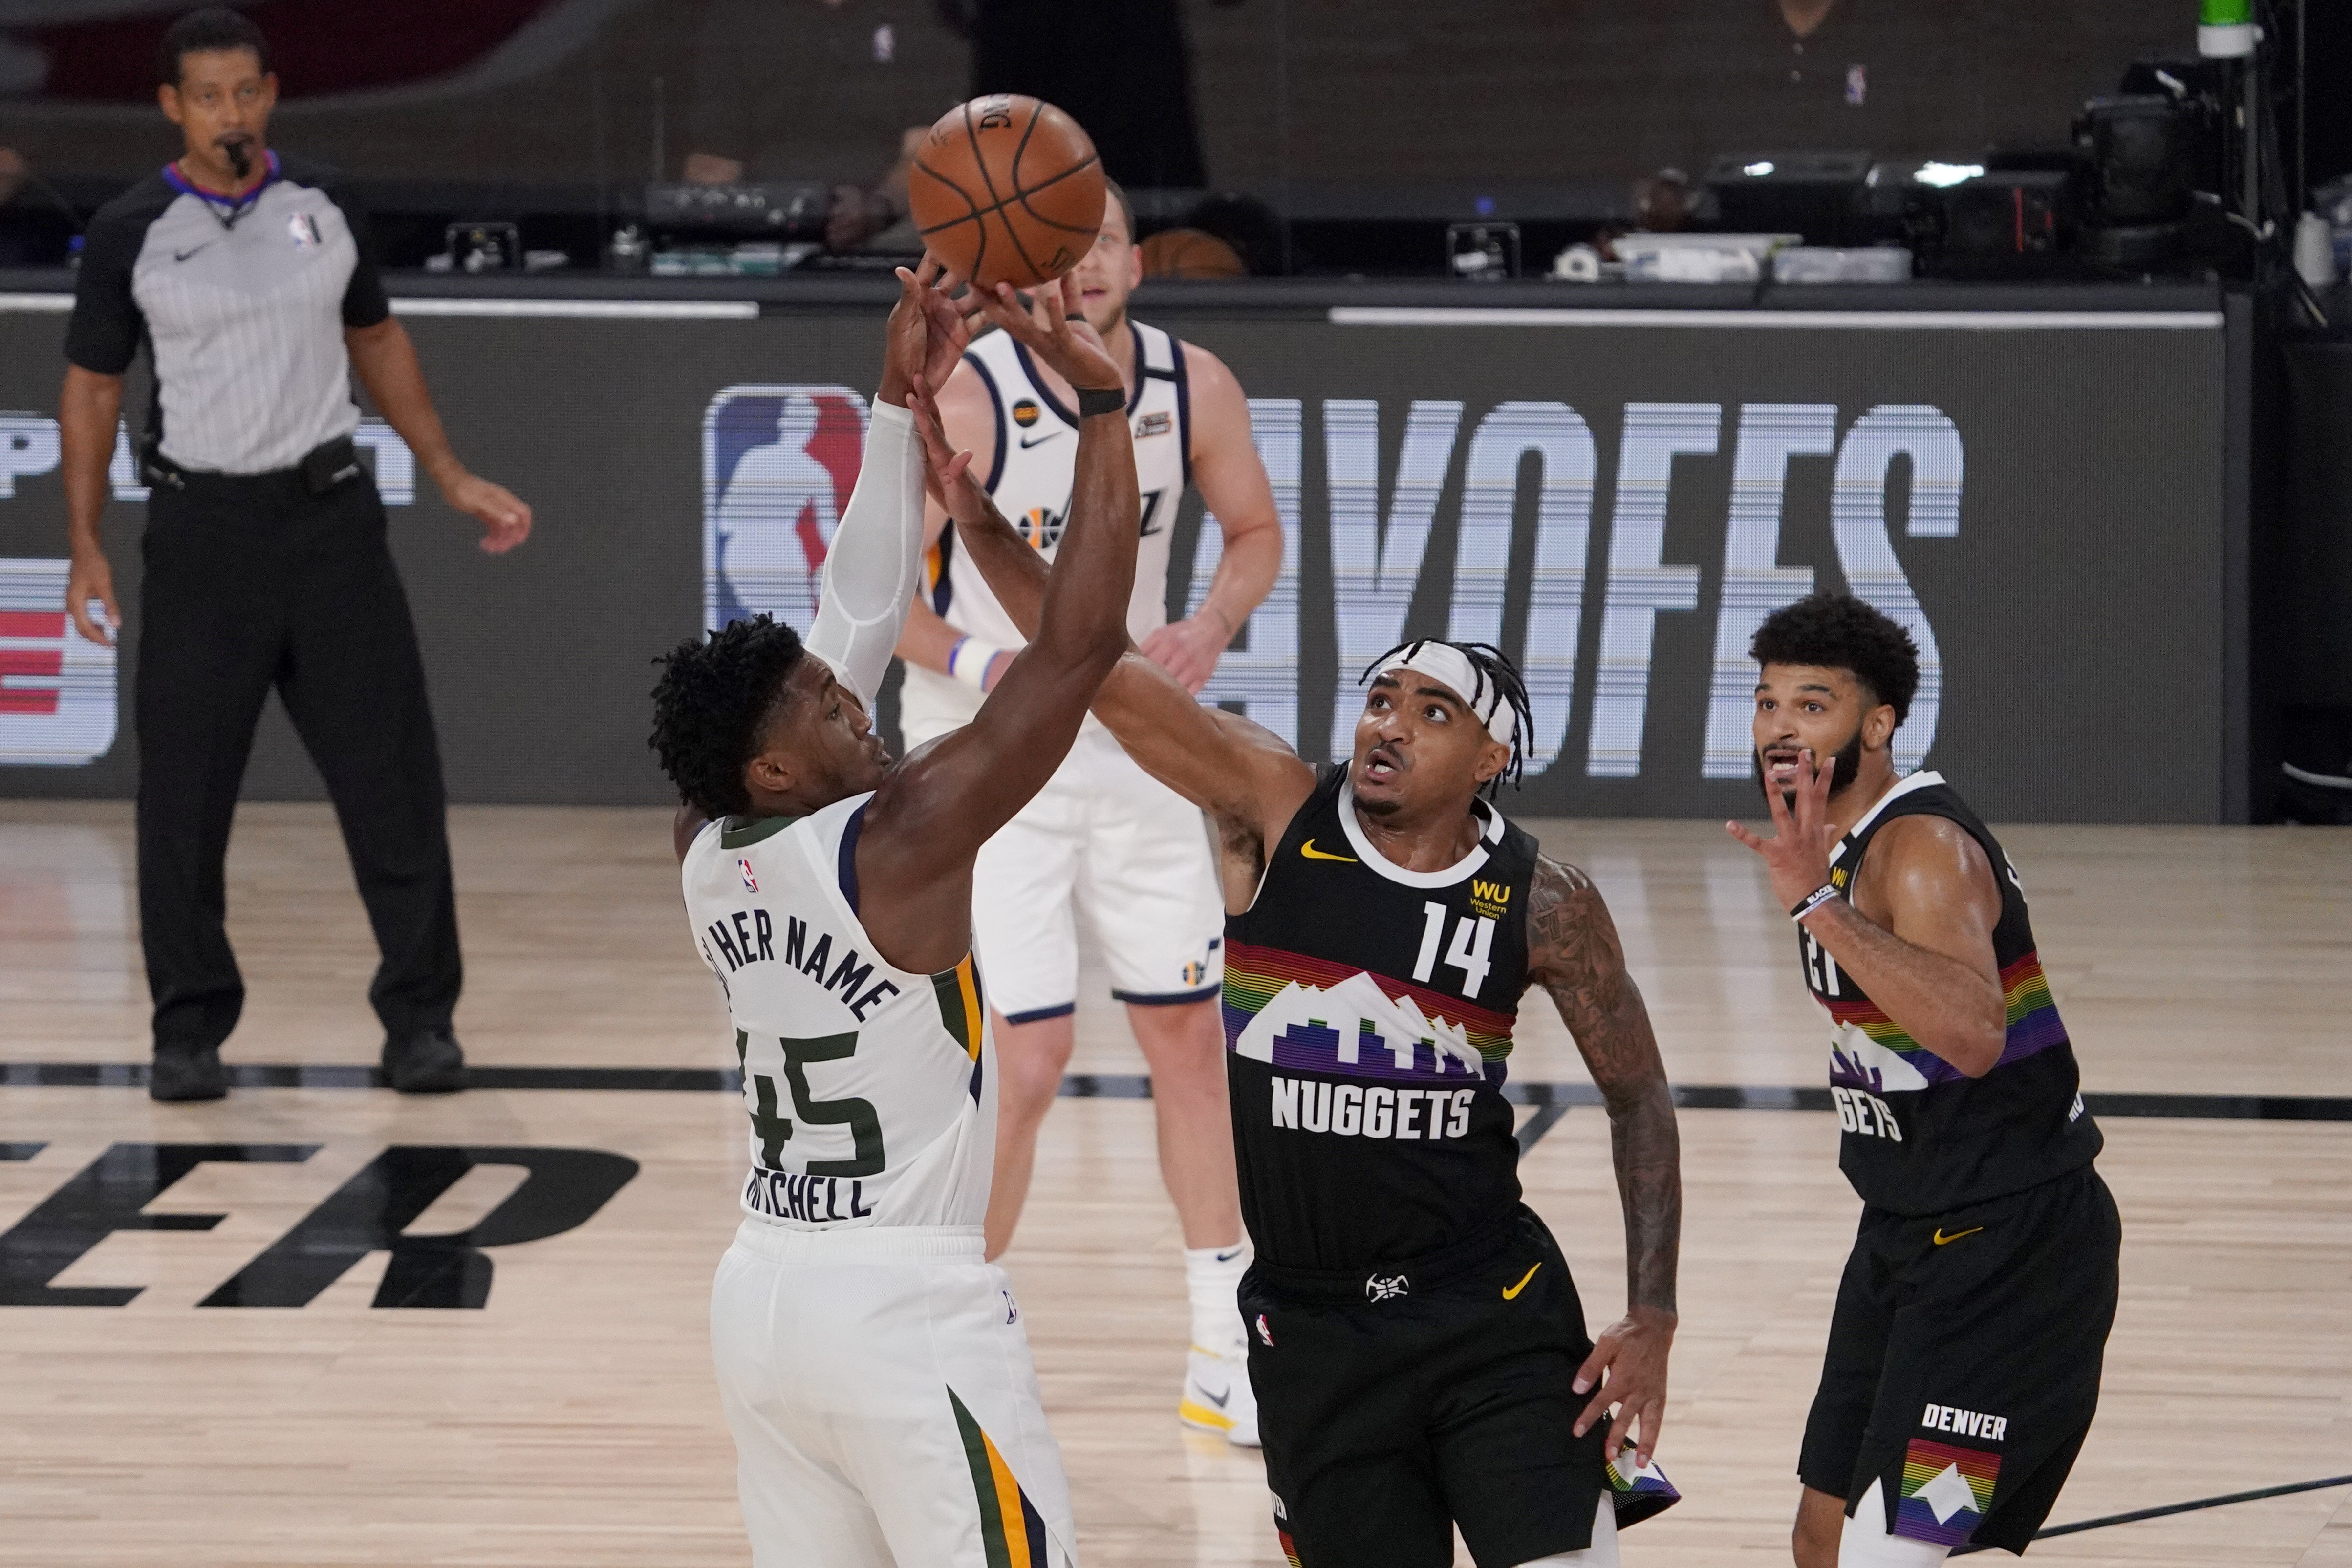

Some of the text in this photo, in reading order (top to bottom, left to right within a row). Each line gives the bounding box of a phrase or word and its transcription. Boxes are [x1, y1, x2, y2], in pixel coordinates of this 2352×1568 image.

[1182, 398, 1964, 780] AYOFFS
[1470, 897, 1507, 914] Western
[1473, 879, 1511, 903] WU
[1832, 866, 1848, 888] WU
[1475, 905, 1500, 920] Union
[708, 909, 774, 973] HER
[785, 915, 900, 1023] NAME
[1412, 900, 1497, 999] 14
[736, 1027, 886, 1178] 45
[1271, 1076, 1476, 1140] NUGGETS
[1831, 1086, 1903, 1142] GETS
[0, 1142, 640, 1310] ER
[1921, 1402, 2008, 1441] DENVER
